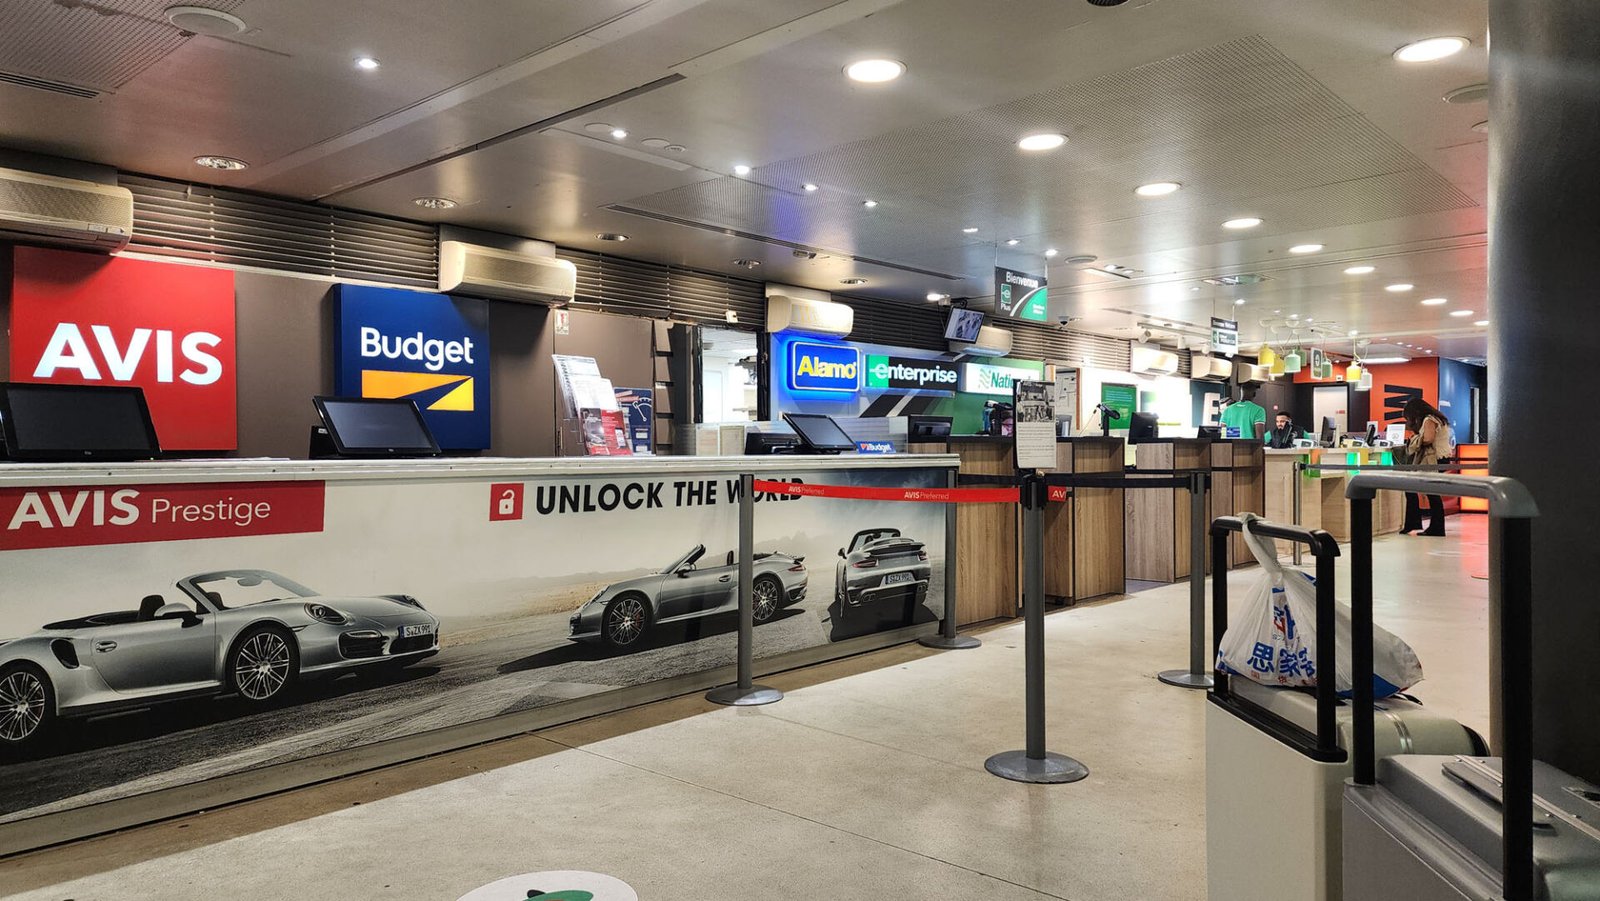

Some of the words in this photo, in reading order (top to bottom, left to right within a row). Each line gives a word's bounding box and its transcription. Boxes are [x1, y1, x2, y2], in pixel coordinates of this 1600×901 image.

[1005, 271, 1039, 288] Bienvenue
[33, 322, 222, 386] AVIS
[361, 326, 474, 371] Budget
[797, 355, 857, 379] Alamo
[870, 363, 957, 386] enterprise
[990, 371, 1014, 389] Nati
[536, 482, 664, 515] UNLOCK
[674, 480, 718, 507] THE
[788, 485, 801, 493] AVIS
[904, 491, 920, 499] AVIS
[920, 491, 949, 499] Preferred
[7, 489, 140, 530] AVIS
[151, 496, 271, 526] Prestige
